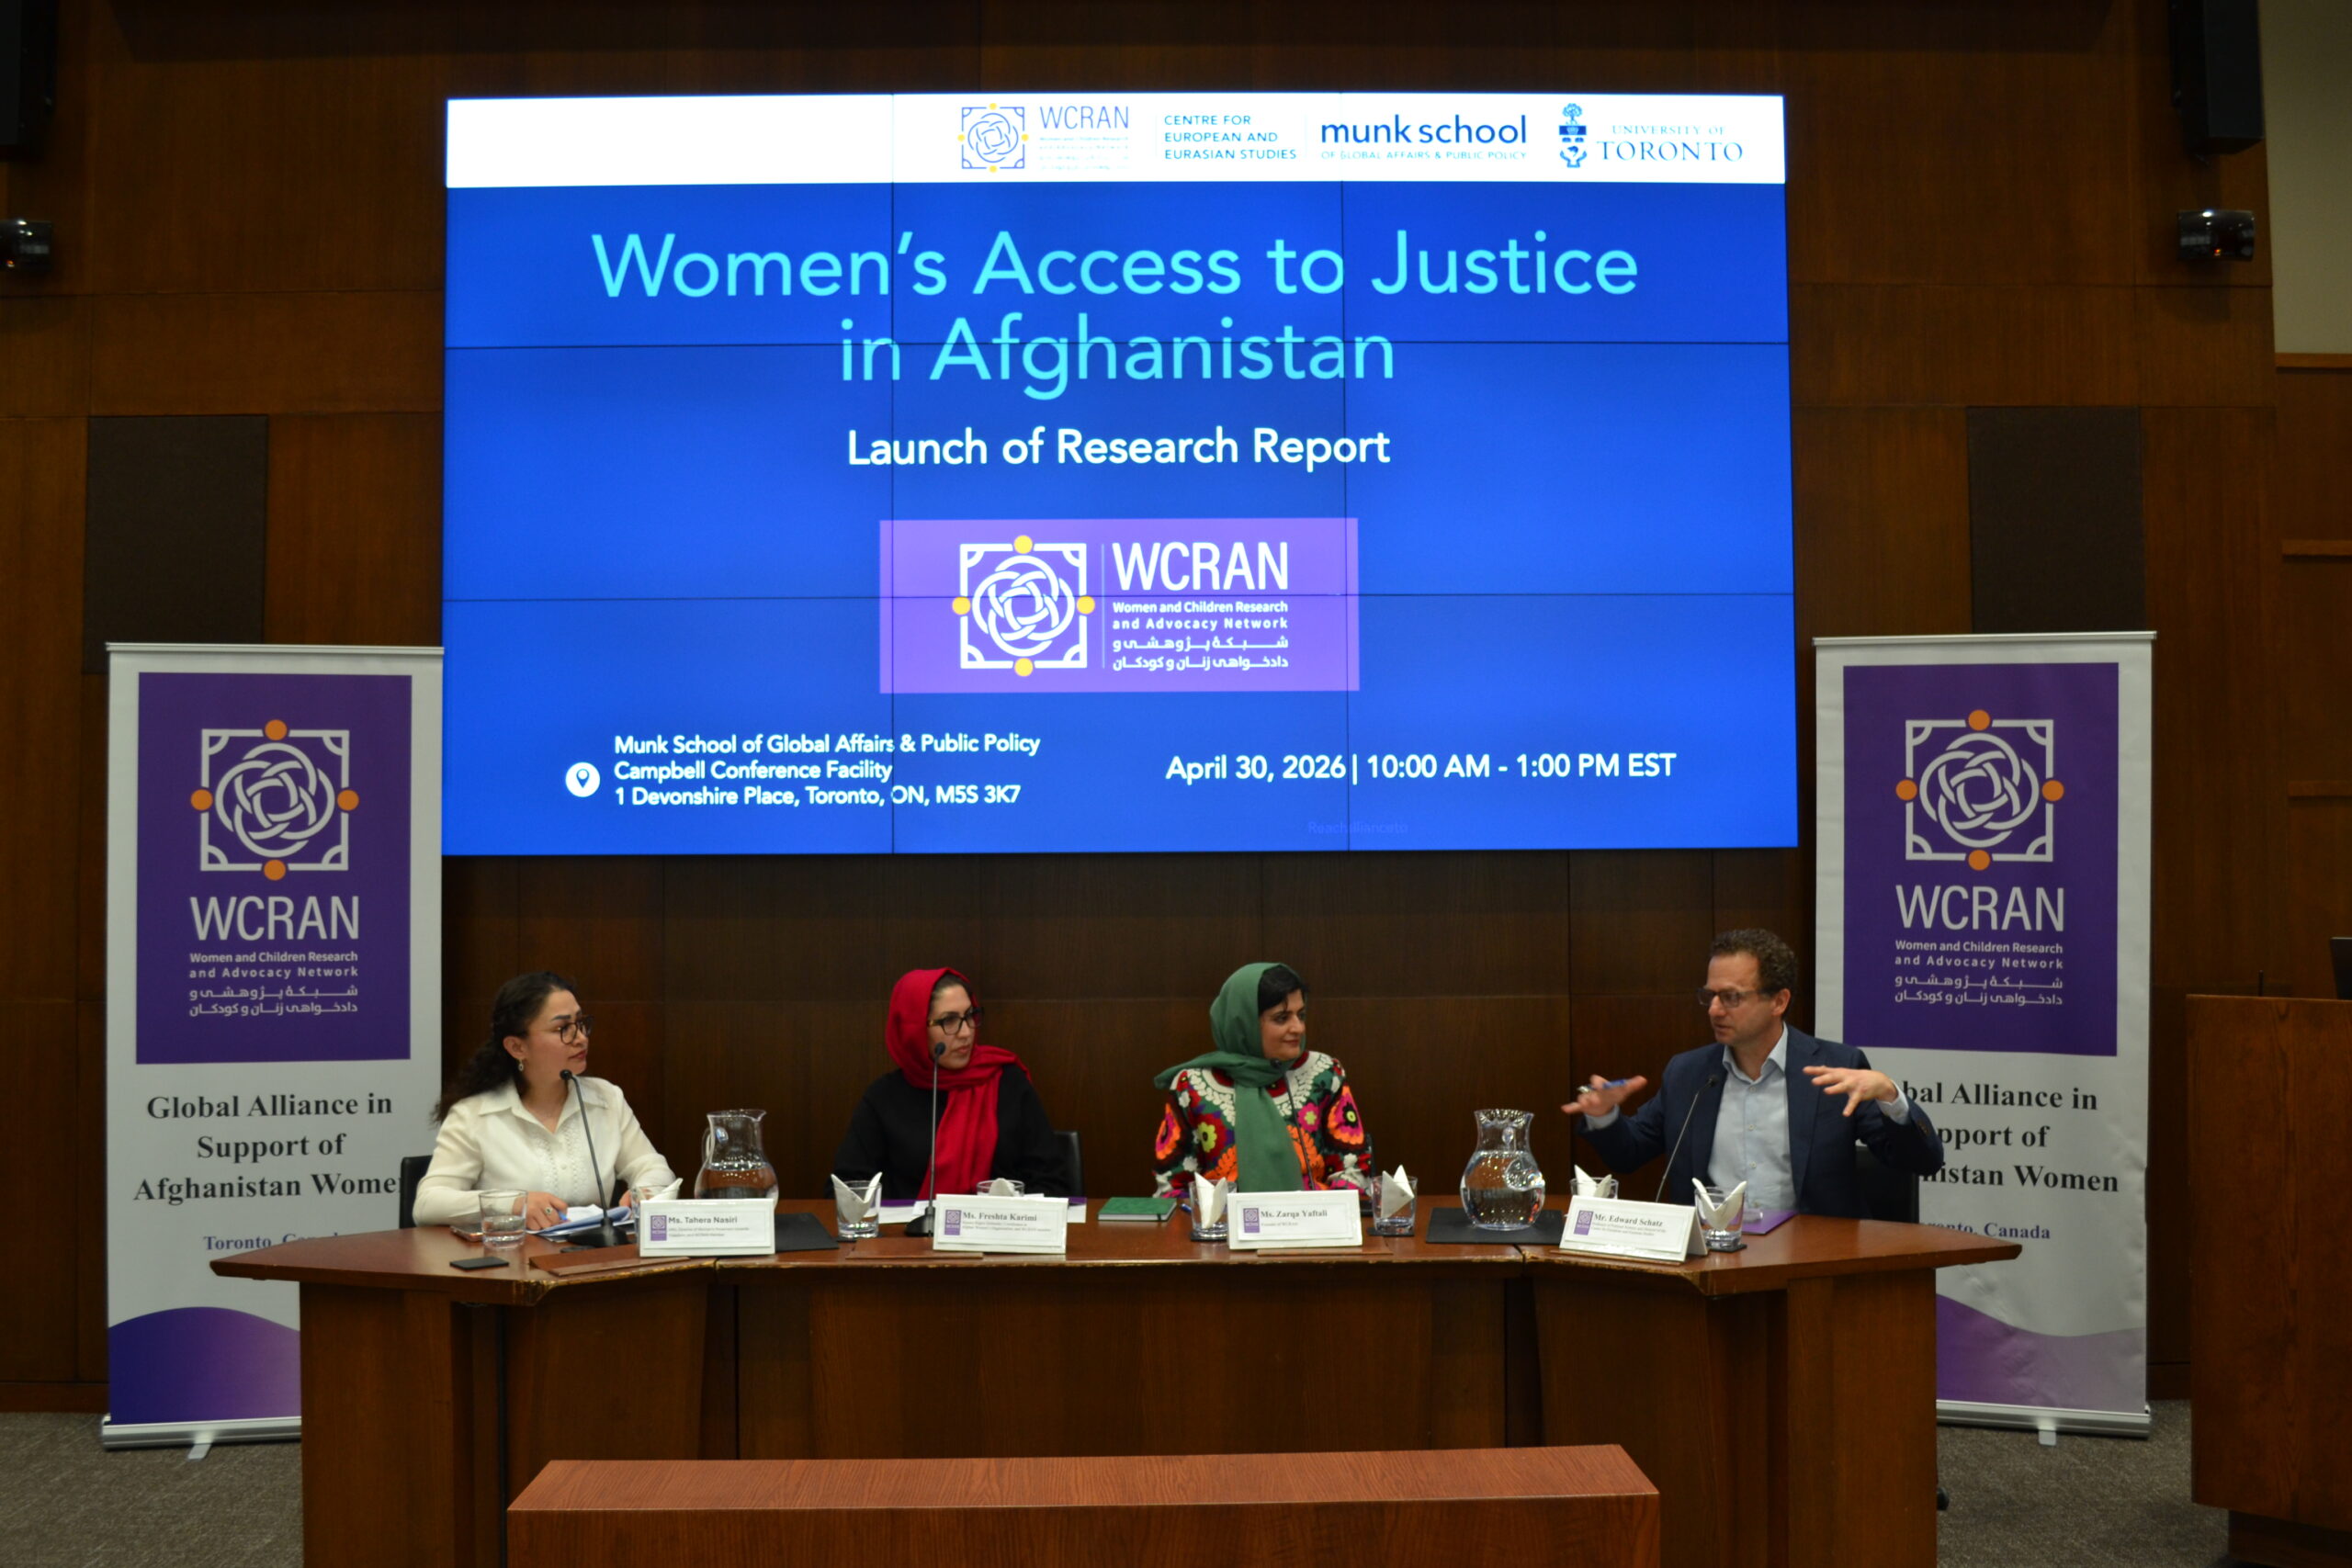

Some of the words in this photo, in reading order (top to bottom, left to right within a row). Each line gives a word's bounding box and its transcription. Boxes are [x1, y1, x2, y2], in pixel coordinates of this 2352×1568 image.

[1040, 106, 1129, 130] WCRAN
[1164, 115, 1218, 125] CENTRE
[1224, 115, 1251, 125] FOR
[1321, 114, 1413, 143] munk
[1419, 114, 1526, 143] school
[1164, 132, 1241, 142] EUROPEAN
[1247, 132, 1278, 142] AND
[1611, 125, 1701, 135] UNIVERSITY
[1708, 126, 1726, 136] OF
[1165, 149, 1235, 160] EURASIAN
[1240, 149, 1296, 160] STUDIES
[1321, 151, 1336, 160] OF
[1386, 151, 1430, 160] AFFAIRS
[1434, 151, 1442, 160] &
[1446, 151, 1484, 160] PUBLIC
[1488, 151, 1526, 160] POLICY
[1596, 141, 1743, 162] TORONTO
[972, 231, 1240, 297] Access
[1267, 244, 1345, 295] to
[1370, 229, 1638, 296] Justice
[840, 318, 901, 381] in
[929, 313, 1396, 400] Afghanistan
[848, 430, 988, 468] Launch
[1001, 429, 1046, 467] of
[1056, 427, 1238, 466] Research
[1252, 426, 1391, 471] Report
[1112, 542, 1288, 591] WCRAN
[1113, 602, 1157, 613] Women
[1159, 601, 1182, 613] and
[1183, 601, 1233, 613] Children
[1236, 600, 1288, 613] Research
[1113, 617, 1139, 629] and
[1146, 617, 1217, 631] Advocacy
[1224, 616, 1288, 629] Network
[615, 736, 669, 753] Munk
[673, 735, 737, 753] School
[741, 735, 763, 752] of
[766, 734, 829, 753] Global
[835, 733, 894, 752] Affairs
[899, 734, 917, 752] &
[921, 732, 978, 752] Public
[984, 732, 1041, 756] Policy
[614, 761, 706, 784] Campbell
[710, 761, 821, 780] Conference
[827, 761, 893, 784] Facility
[1165, 754, 1227, 784] April
[1235, 755, 1274, 783] 30,
[1367, 754, 1437, 779] 10:00
[1443, 754, 1490, 778] AM
[1516, 754, 1570, 778] 1:00
[1577, 753, 1620, 777] PM
[1628, 752, 1677, 776] EST
[616, 788, 625, 805] 1
[631, 786, 738, 805] Devonshire
[743, 786, 800, 807] Place,
[805, 786, 886, 807] Toronto,
[891, 785, 930, 807] ON,
[935, 785, 979, 805] M5S
[984, 784, 1022, 804] 3K7
[189, 896, 359, 941] WCRAN
[1895, 885, 2064, 932] WCRAN
[190, 953, 232, 963] Women
[235, 952, 256, 963] and
[258, 951, 306, 962] Children
[309, 951, 358, 962] Research
[1895, 940, 1937, 951] Women
[1939, 941, 1961, 952] and
[1962, 942, 2009, 953] Children
[2012, 942, 2063, 953] Research
[189, 967, 216, 978] and
[222, 967, 291, 979] Advocacy
[298, 966, 358, 976] Network
[1894, 955, 1920, 964] and
[1927, 955, 1995, 969] Advocacy
[2002, 957, 2063, 969] Network
[147, 1096, 239, 1119] Global
[248, 1094, 358, 1116] Alliance
[368, 1092, 392, 1114] in
[1903, 1080, 1942, 1103] bal
[1951, 1082, 2063, 1108] Alliance
[2072, 1088, 2098, 1111] in
[198, 1134, 309, 1163] Support
[319, 1133, 345, 1156] of
[1937, 1126, 2013, 1150] pport
[2021, 1125, 2051, 1147] of
[133, 1175, 301, 1205] Afghanistan
[311, 1173, 401, 1195] Wome
[2014, 1165, 2119, 1192] Women
[1984, 1223, 2051, 1239] Canada
